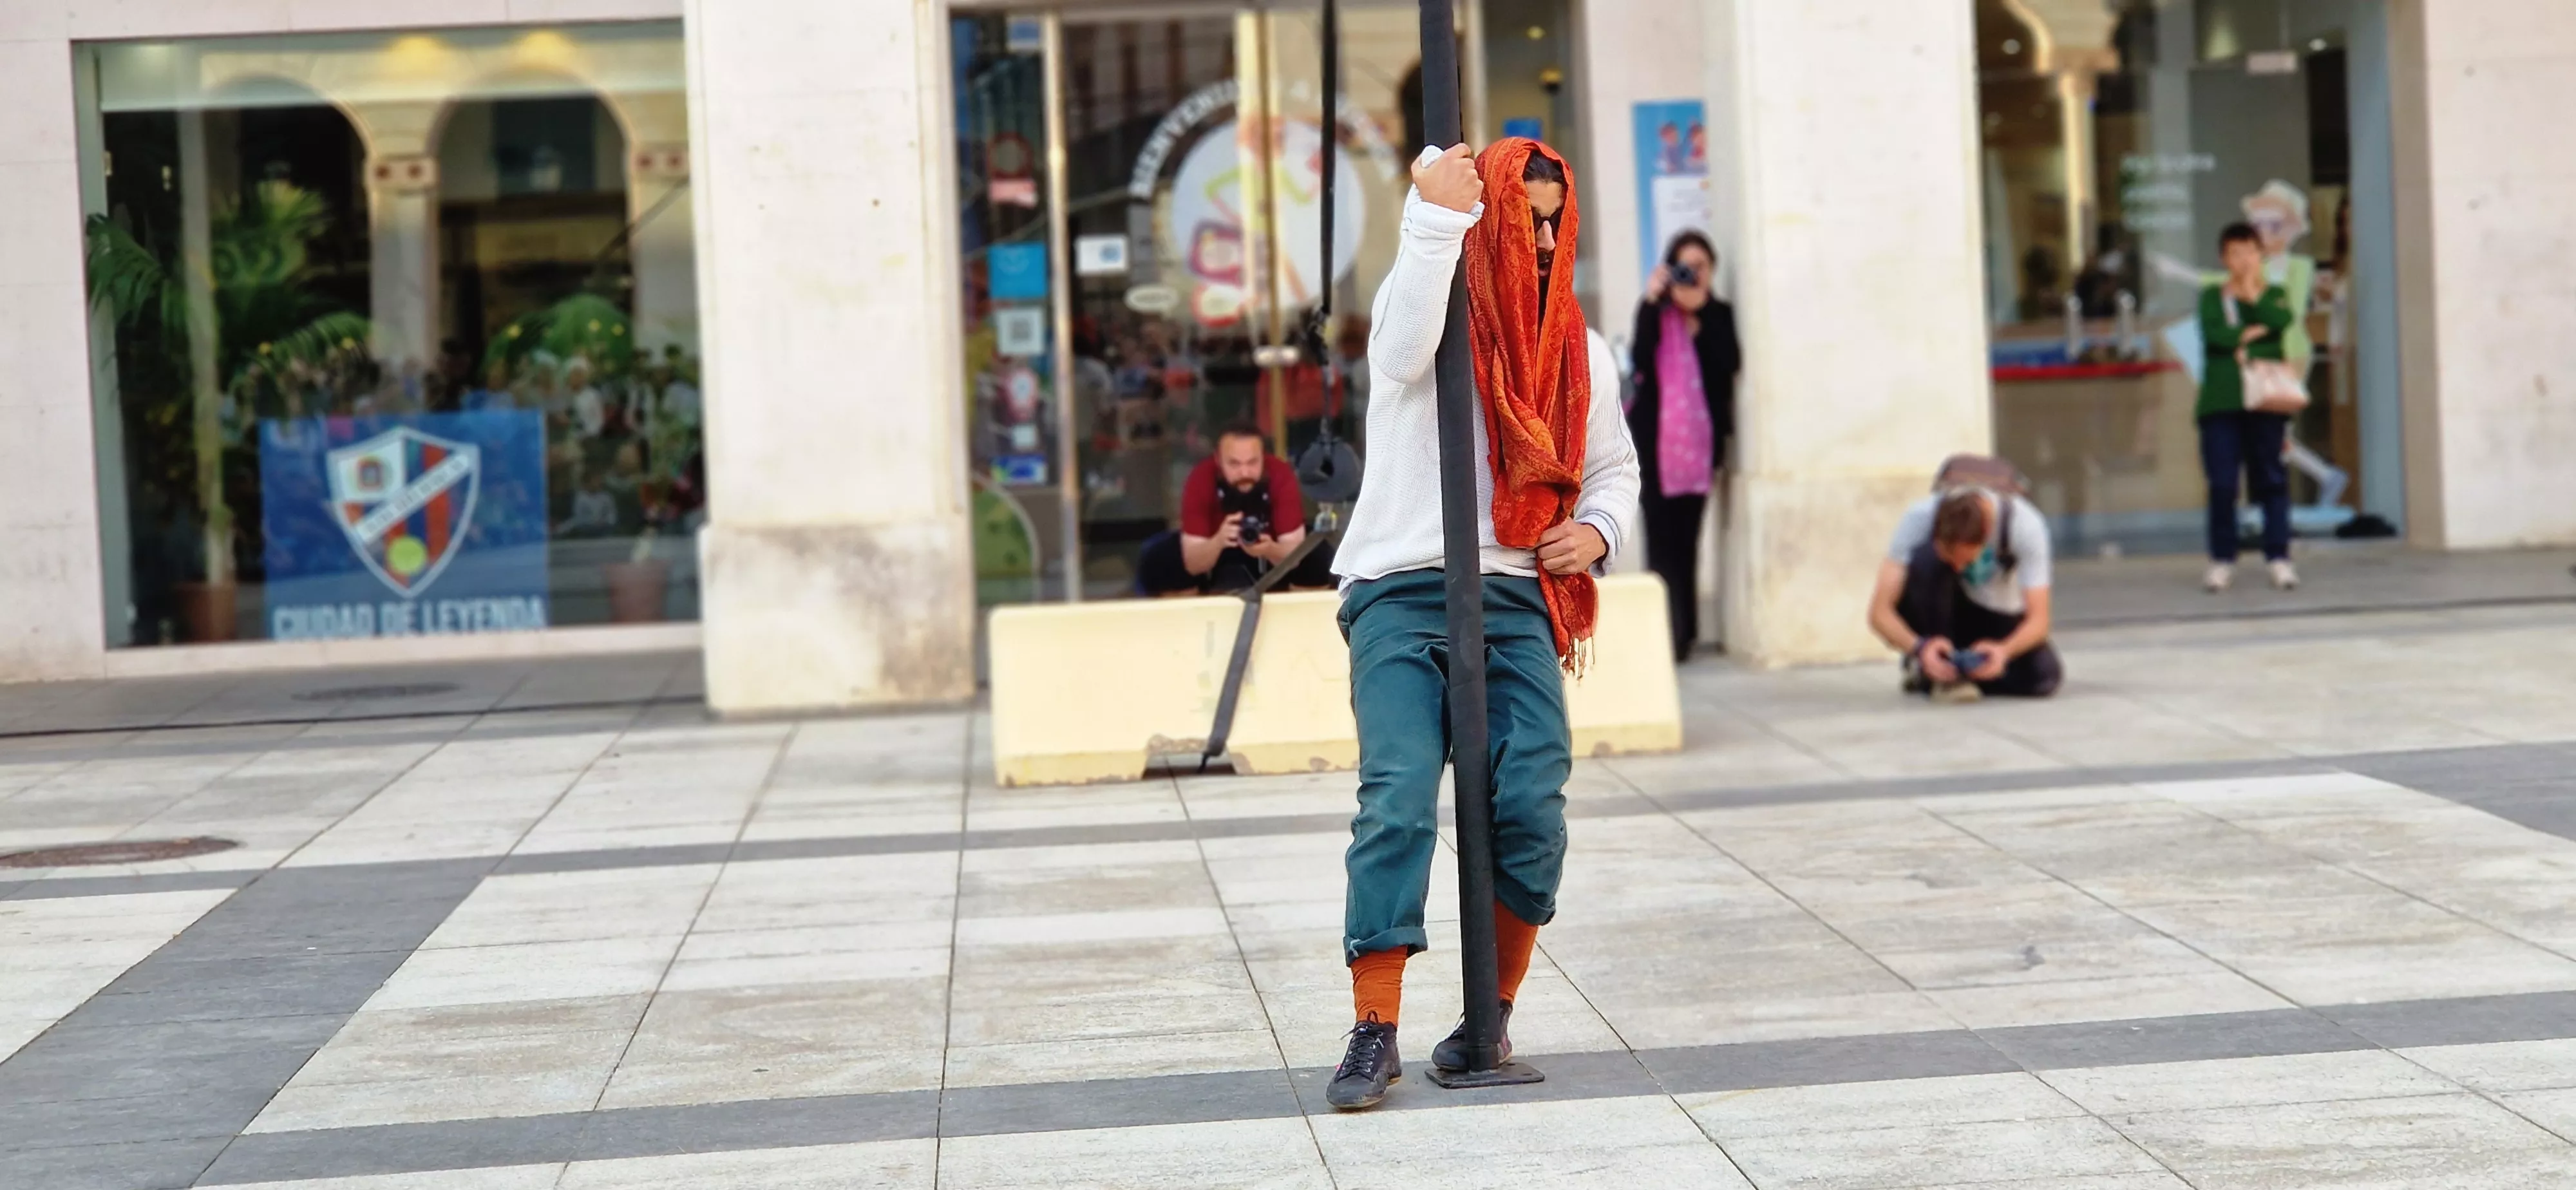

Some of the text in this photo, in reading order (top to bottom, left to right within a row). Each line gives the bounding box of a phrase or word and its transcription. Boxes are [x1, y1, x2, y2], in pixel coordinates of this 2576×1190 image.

[272, 595, 546, 641] CIUDAD DE LEYENDA
